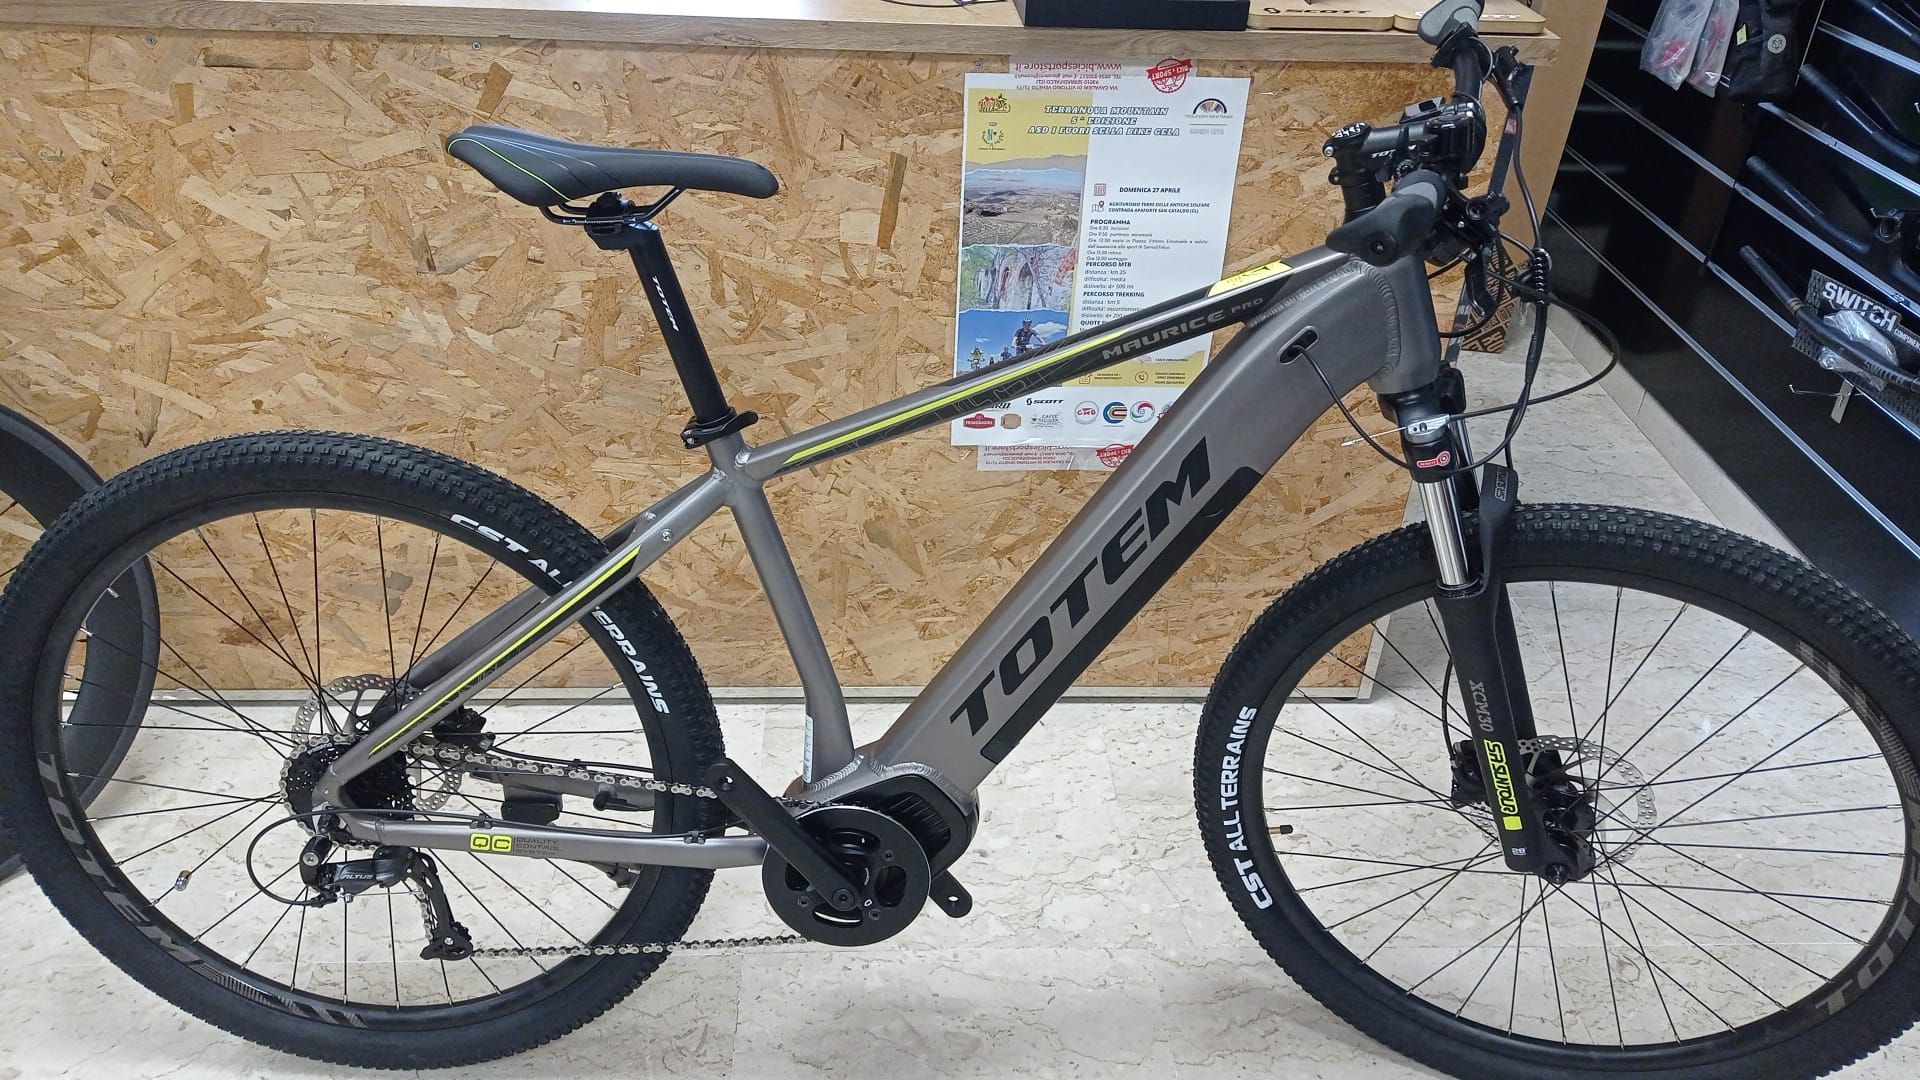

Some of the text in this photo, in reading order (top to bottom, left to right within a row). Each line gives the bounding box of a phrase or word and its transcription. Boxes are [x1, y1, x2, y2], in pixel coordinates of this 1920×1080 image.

[1014, 60, 1122, 72] www.biciesportstore.it
[1151, 68, 1172, 80] SPORT
[1028, 126, 1050, 135] ASD
[1058, 127, 1090, 136] FUORI
[1092, 127, 1123, 136] SELLA
[1125, 127, 1152, 136] BIKE
[1044, 105, 1169, 116] TERRANOVA MOUNTAIN
[1086, 117, 1138, 126] EDIZIONE
[652, 275, 680, 332] TOTEM
[1822, 281, 1898, 332] SWITCH
[1101, 298, 1264, 360] MAURICE PRO
[450, 513, 530, 554] CST
[950, 436, 1211, 737] TOTEM
[1469, 679, 1494, 732] XCM30
[1220, 705, 1274, 910] CST ALL TERRAINS
[1491, 763, 1517, 814] SUNTOUR
[516, 843, 562, 852] CONTROL
[341, 872, 373, 881] ALTUS
